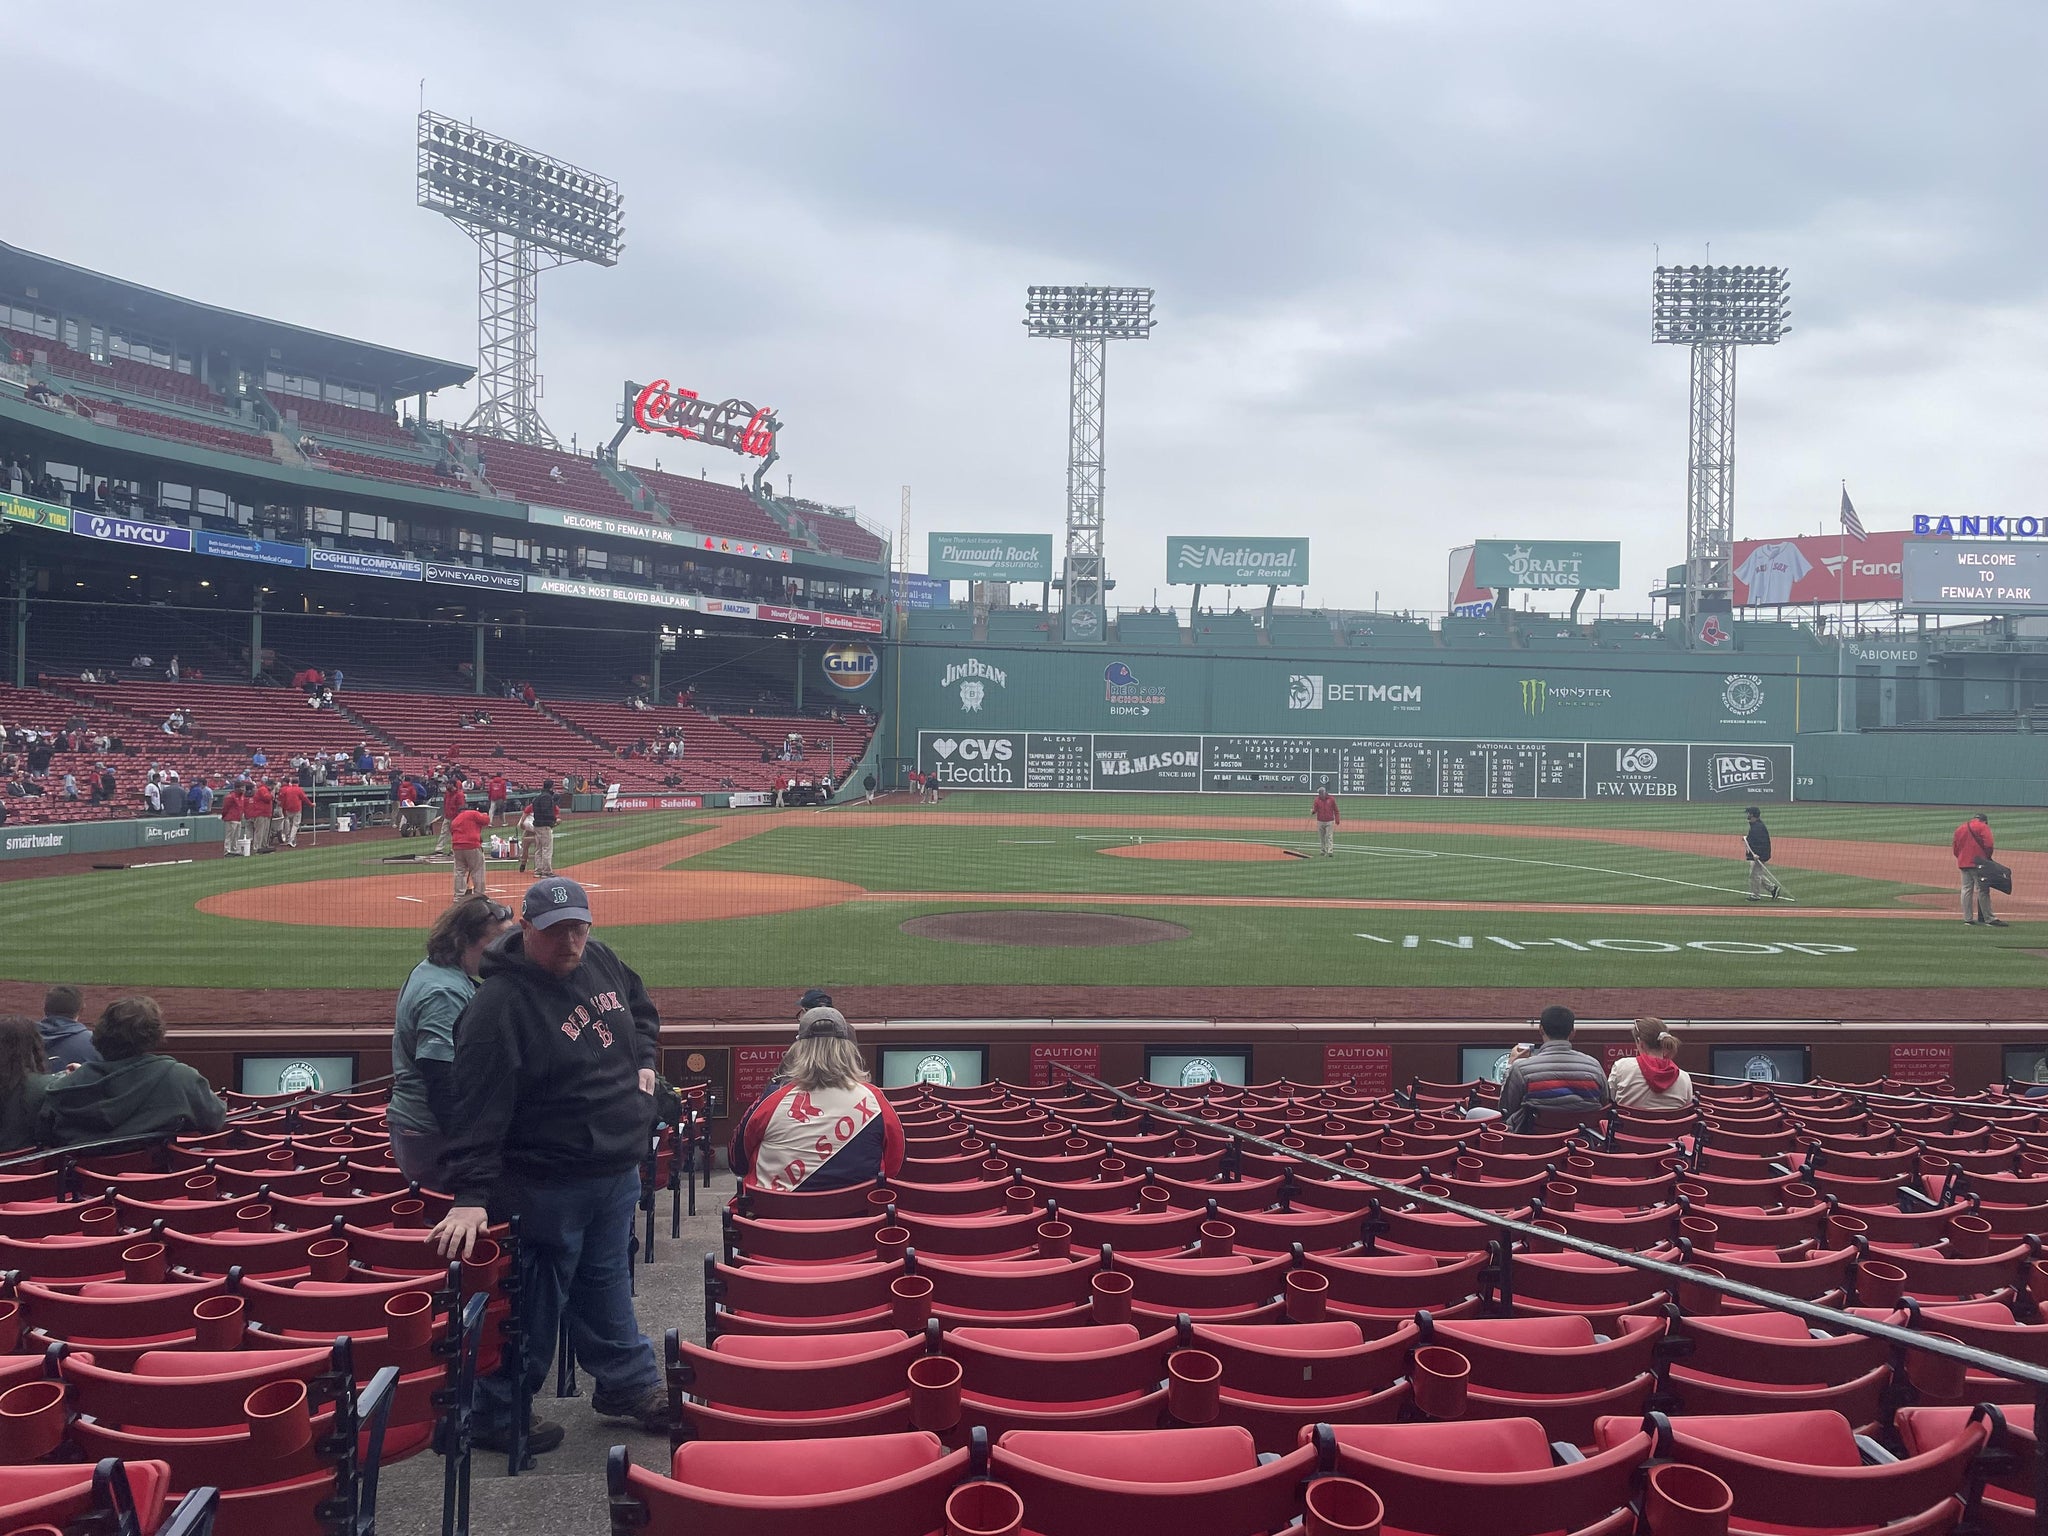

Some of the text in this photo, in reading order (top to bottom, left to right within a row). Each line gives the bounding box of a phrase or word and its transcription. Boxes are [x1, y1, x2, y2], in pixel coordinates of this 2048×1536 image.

[634, 379, 778, 457] Coca-Cola
[49, 512, 67, 526] TIRE
[1913, 515, 2048, 537] BANK O
[115, 523, 166, 543] HYCU
[563, 515, 673, 541] WELCOME TO FENWAY PARK
[234, 551, 259, 560] Deaconess
[260, 554, 277, 562] Medical
[942, 545, 1039, 562] Plymouth Rock
[1205, 548, 1297, 567] National
[1958, 554, 2016, 565] WELCOME
[313, 552, 421, 572] COGHLIN COMPANIES
[1508, 559, 1582, 574] DRAFT
[1852, 559, 1904, 577] Fana
[438, 569, 520, 587] VINEYARD VINES
[1518, 573, 1580, 586] KINGS
[1979, 571, 1995, 582] TO
[541, 580, 690, 607] AMERICA'S MOST BELOVED BALLPARK
[1941, 587, 2032, 599] FENWAY PARK
[723, 603, 750, 615] AMAZING
[771, 609, 810, 622] Ninety Nine
[1455, 602, 1494, 618] CITGO
[824, 616, 852, 628] Safelite
[1860, 650, 1918, 660] ABIOMED
[825, 655, 874, 671] Gulf
[941, 658, 1007, 688] JIM BEAM
[1111, 686, 1166, 695] RED SOX
[1328, 684, 1422, 702] BETMGM
[1549, 687, 1612, 698] MONSTER
[1110, 695, 1166, 704] SCHOLARS
[1110, 706, 1139, 715] BIDMC
[959, 739, 1013, 760] CVS
[1114, 751, 1127, 759] BUT
[1616, 748, 1658, 772] 160
[1720, 757, 1766, 773] ACE
[936, 762, 1013, 782] Health
[1722, 772, 1767, 784] TICKET
[1796, 777, 1813, 786] 379
[1597, 782, 1678, 796] F.W. WEBB
[614, 799, 648, 808] afelite
[660, 798, 697, 808] Safelite
[6, 833, 63, 850] smartwater
[147, 828, 190, 841] ACE TICKET
[551, 886, 568, 904] B
[561, 992, 622, 1041] RED SOX
[592, 1019, 613, 1047] B
[1034, 1048, 1097, 1057] CAUTION!
[1328, 1049, 1389, 1057] CAUTION!
[1894, 1048, 1950, 1056] CAUTION!
[936, 1056, 948, 1068] PARK
[1200, 1060, 1214, 1073] PARK
[300, 1063, 315, 1076] PARK
[816, 1098, 876, 1160] SOX
